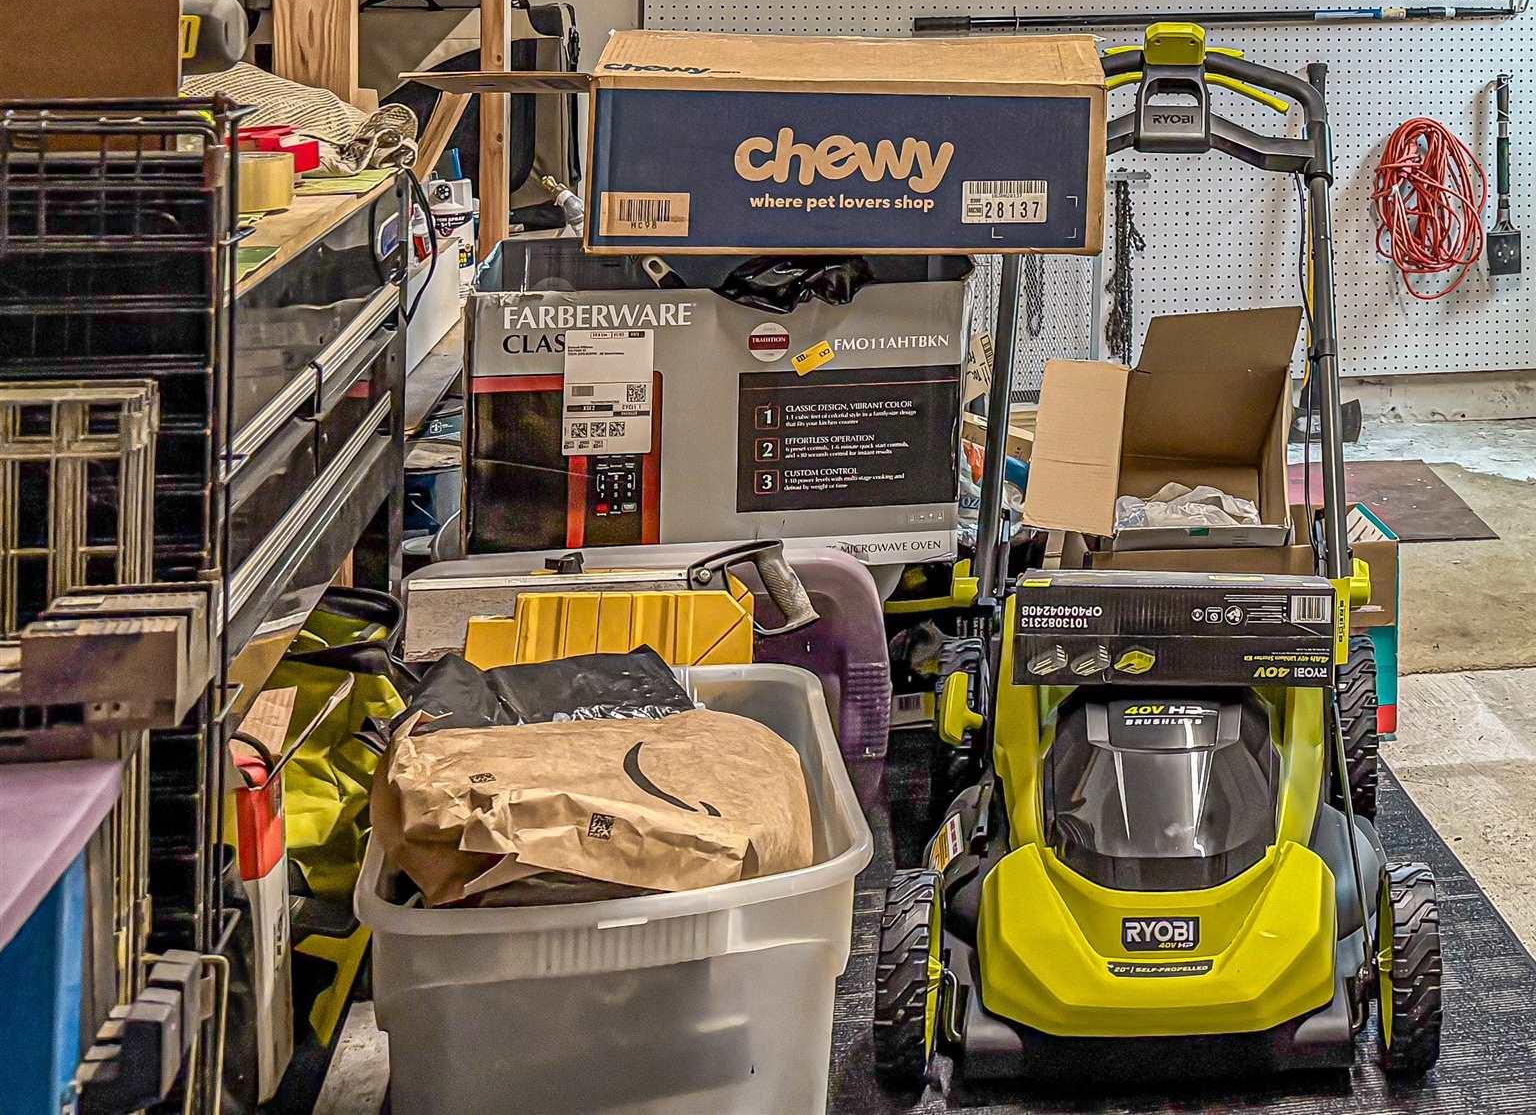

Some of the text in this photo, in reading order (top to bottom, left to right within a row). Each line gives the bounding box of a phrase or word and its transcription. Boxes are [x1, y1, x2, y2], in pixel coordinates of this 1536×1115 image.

[1152, 114, 1194, 124] RYOBI
[734, 127, 955, 194] chewy
[750, 194, 935, 212] where pet lovers shop
[985, 201, 1040, 218] 28137
[503, 303, 692, 330] FARBERWARE
[785, 405, 817, 413] CLASSIC
[884, 400, 913, 409] COLOR
[785, 434, 875, 445] EFFORTLESS OPERATION
[784, 467, 858, 477] CUSTOM CONTROL
[840, 540, 941, 554] MICROWAVE OVEN
[1021, 618, 1089, 628] 1013082313
[1253, 666, 1328, 678] RYOBI 40V
[1124, 706, 1165, 714] 40V
[1125, 921, 1194, 942] RYOBI
[1135, 965, 1209, 973] SELF-PROPELLED
